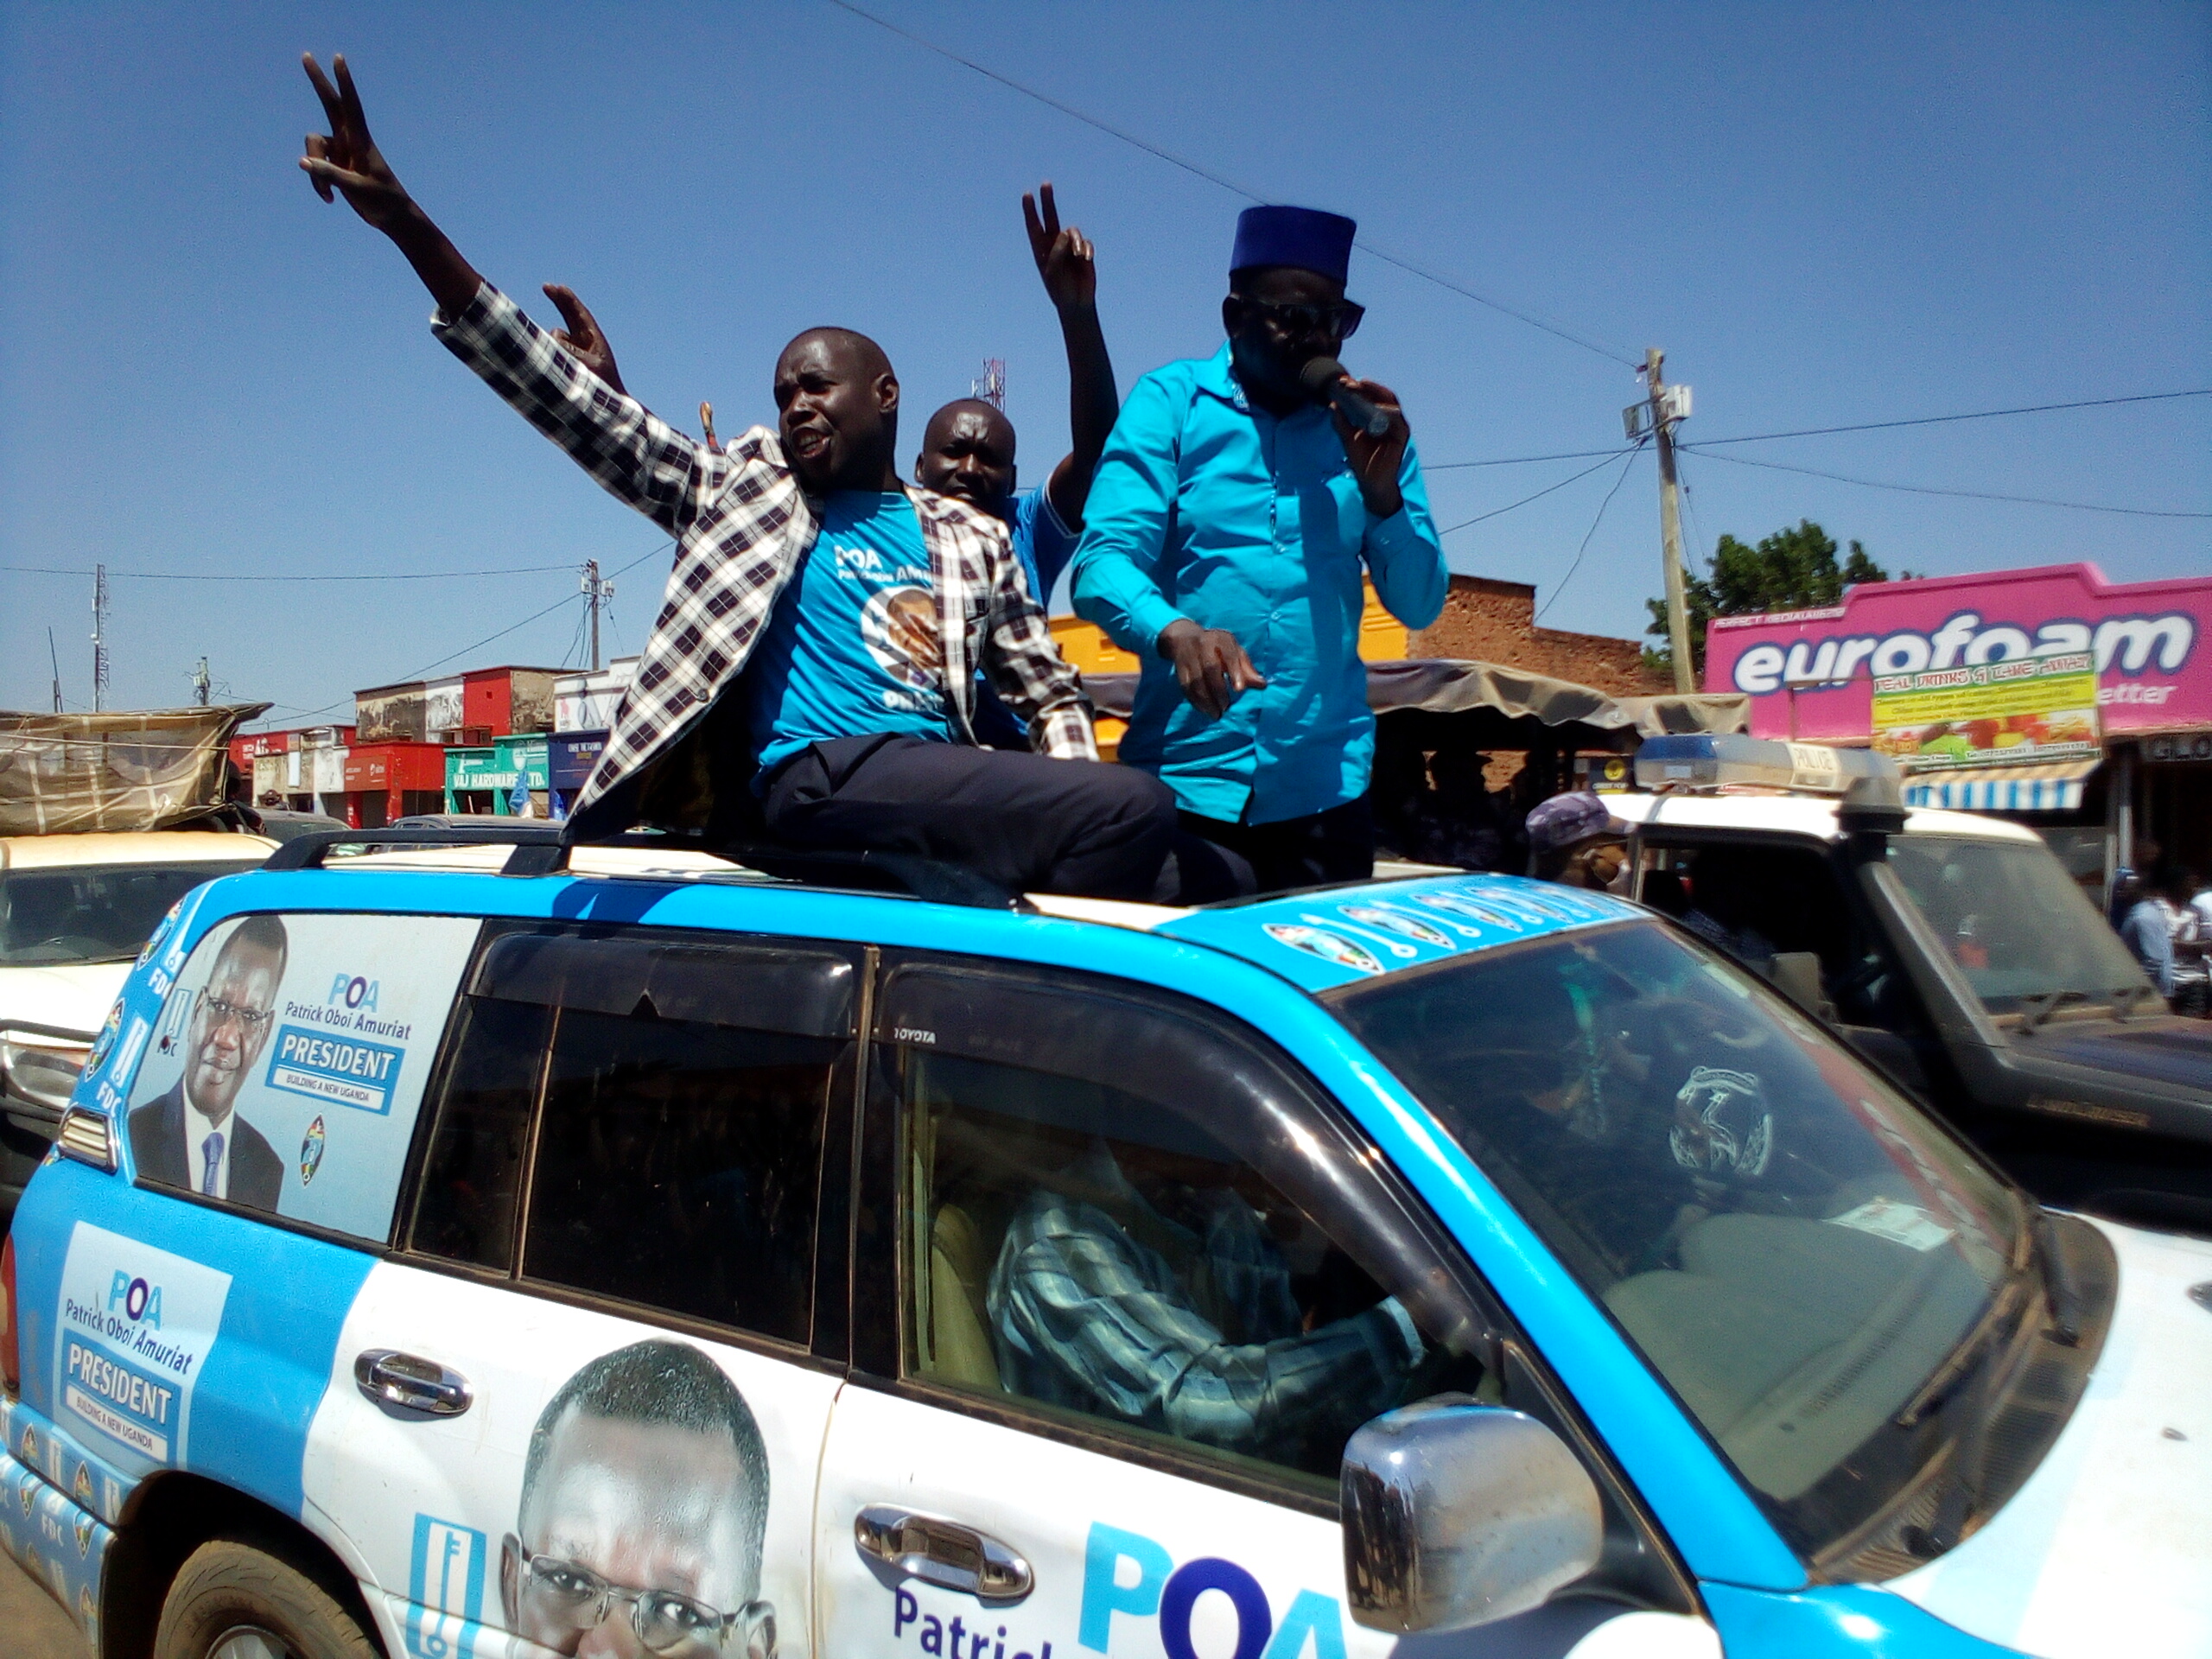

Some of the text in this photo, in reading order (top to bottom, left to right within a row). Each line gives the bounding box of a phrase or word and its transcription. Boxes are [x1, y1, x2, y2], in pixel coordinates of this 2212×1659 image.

[1735, 614, 2193, 692] eurofoam
[1916, 670, 1969, 687] DRINKS
[2097, 683, 2177, 705] etter
[471, 772, 518, 788] HARDWARE
[527, 772, 545, 786] TD.
[327, 972, 380, 1014] POA
[285, 1001, 412, 1039] Patrick Oboi Amuriat
[281, 1033, 396, 1080] PRESIDENT
[96, 1080, 122, 1119] FDC
[286, 1074, 317, 1090] BUILDING
[323, 1083, 339, 1094] NEW
[340, 1088, 370, 1102] UGANDA
[107, 1269, 162, 1332] POA
[66, 1298, 194, 1375] Patrick Oboi Amuriat
[69, 1342, 172, 1425] PRESIDENT
[76, 1396, 101, 1422] BUILDING
[106, 1416, 121, 1434] NEW
[122, 1424, 153, 1451] UGANDA
[1077, 1521, 1348, 1659] POA
[893, 1586, 1052, 1659] Patri
